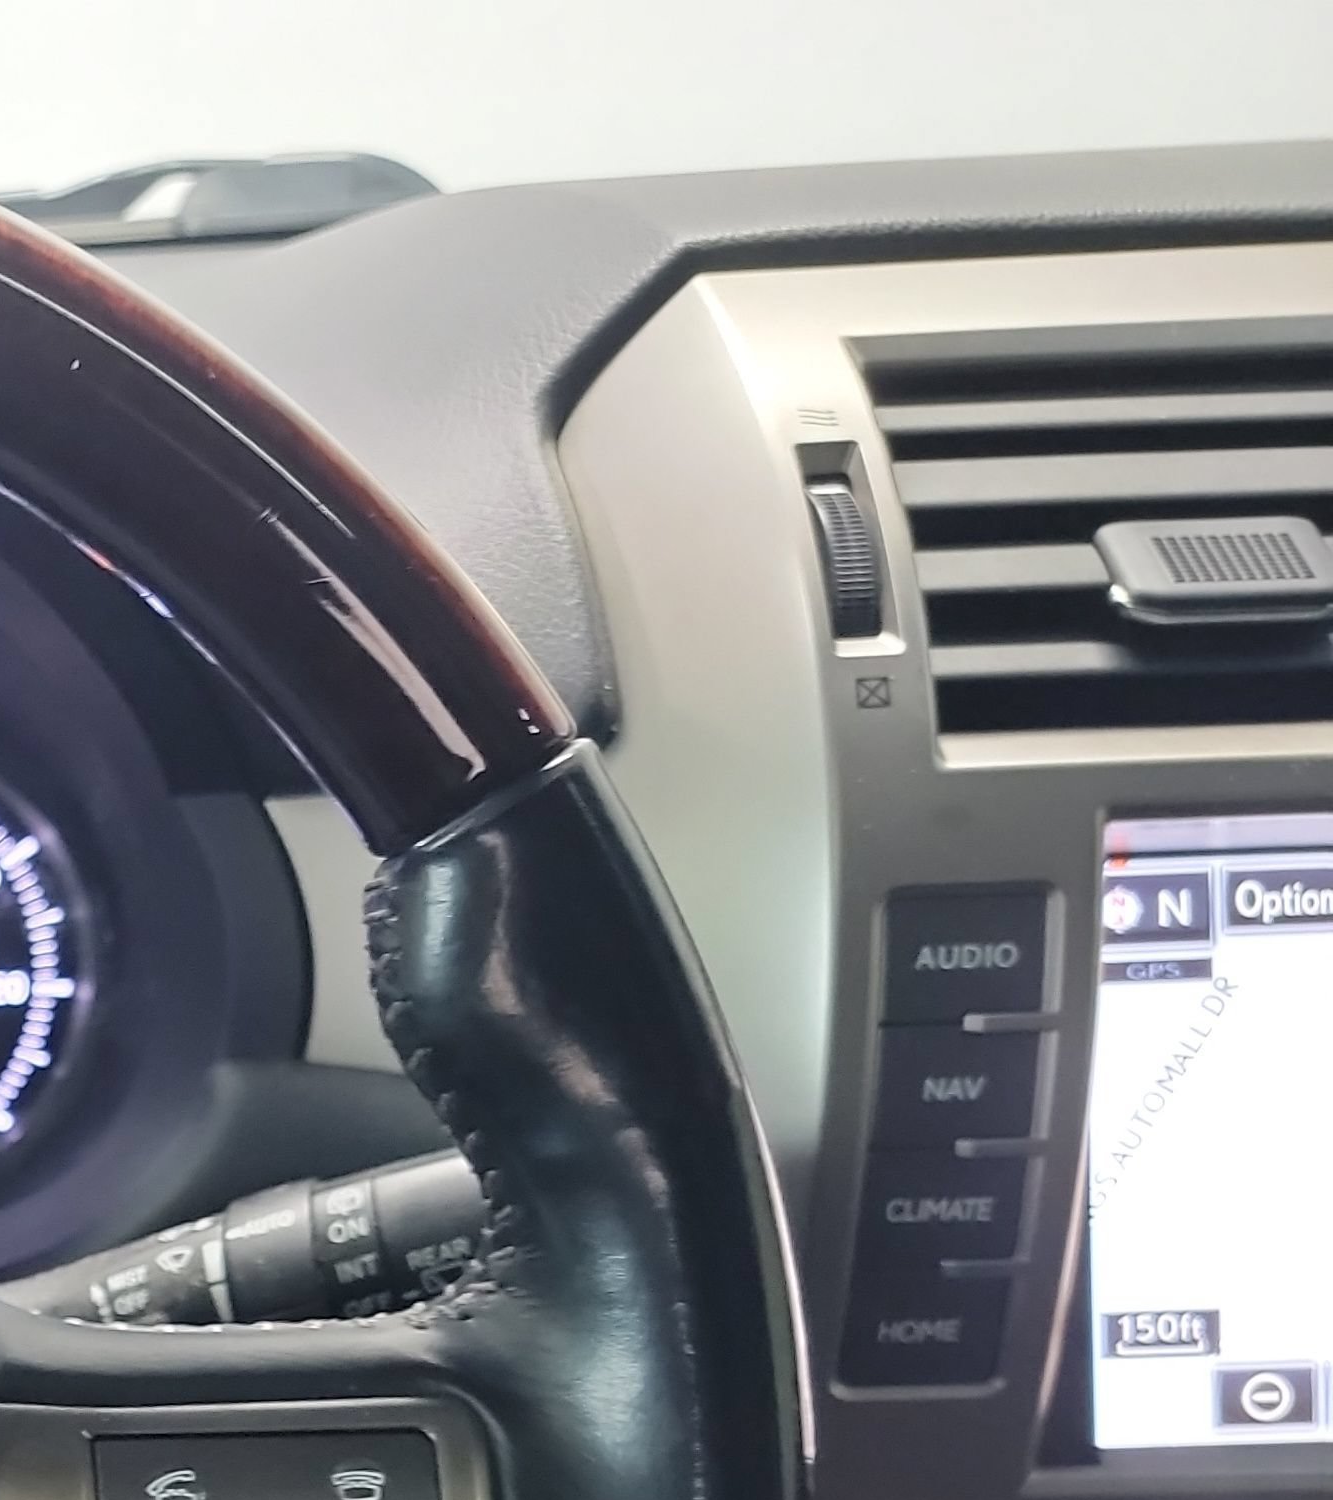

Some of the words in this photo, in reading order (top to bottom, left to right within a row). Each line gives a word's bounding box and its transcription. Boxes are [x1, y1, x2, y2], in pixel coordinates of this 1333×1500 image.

[1157, 887, 1193, 928] N
[914, 943, 1022, 971] AUDIO
[1125, 962, 1182, 981] GPS
[1111, 1025, 1214, 1171] AUTOMALL
[1200, 976, 1240, 1017] DR
[921, 1077, 986, 1102] NAV
[885, 1195, 995, 1224] CLIMATE
[327, 1216, 371, 1245] ON
[877, 1317, 963, 1344] HOME
[1117, 1311, 1208, 1346] 150ft
